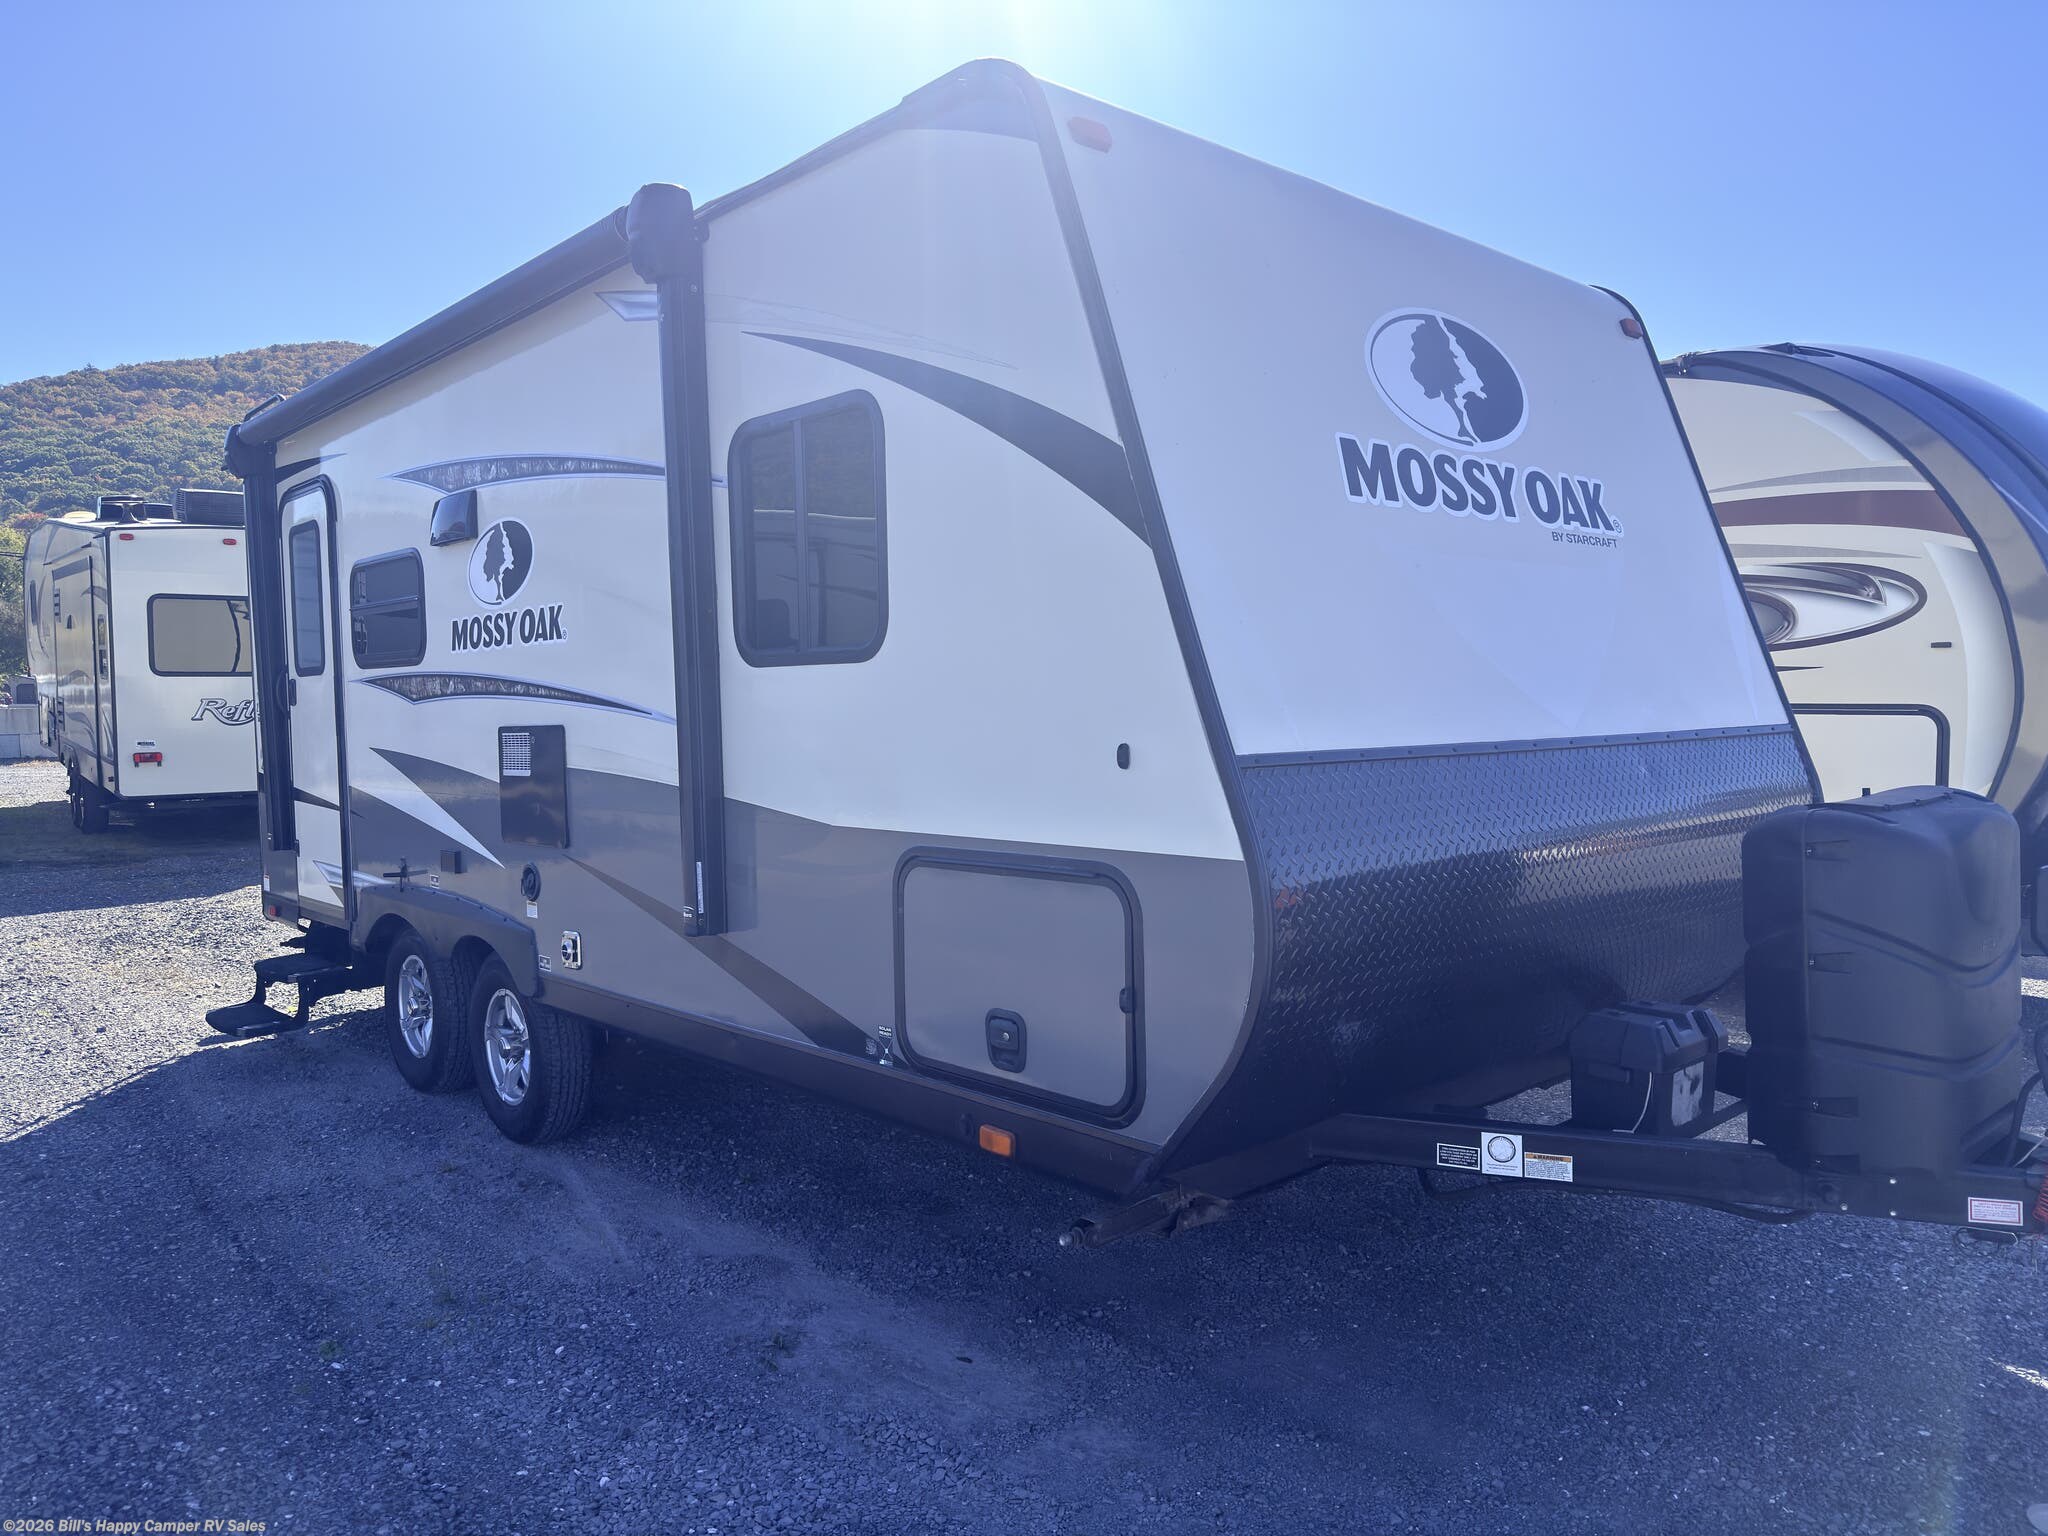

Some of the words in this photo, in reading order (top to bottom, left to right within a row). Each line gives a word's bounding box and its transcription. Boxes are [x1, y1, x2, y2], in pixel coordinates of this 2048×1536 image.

[1339, 436, 1517, 519] MOSSY
[1551, 531, 1564, 542] BY
[1565, 533, 1617, 548] STARCRAFT
[451, 611, 518, 651] MOSSY
